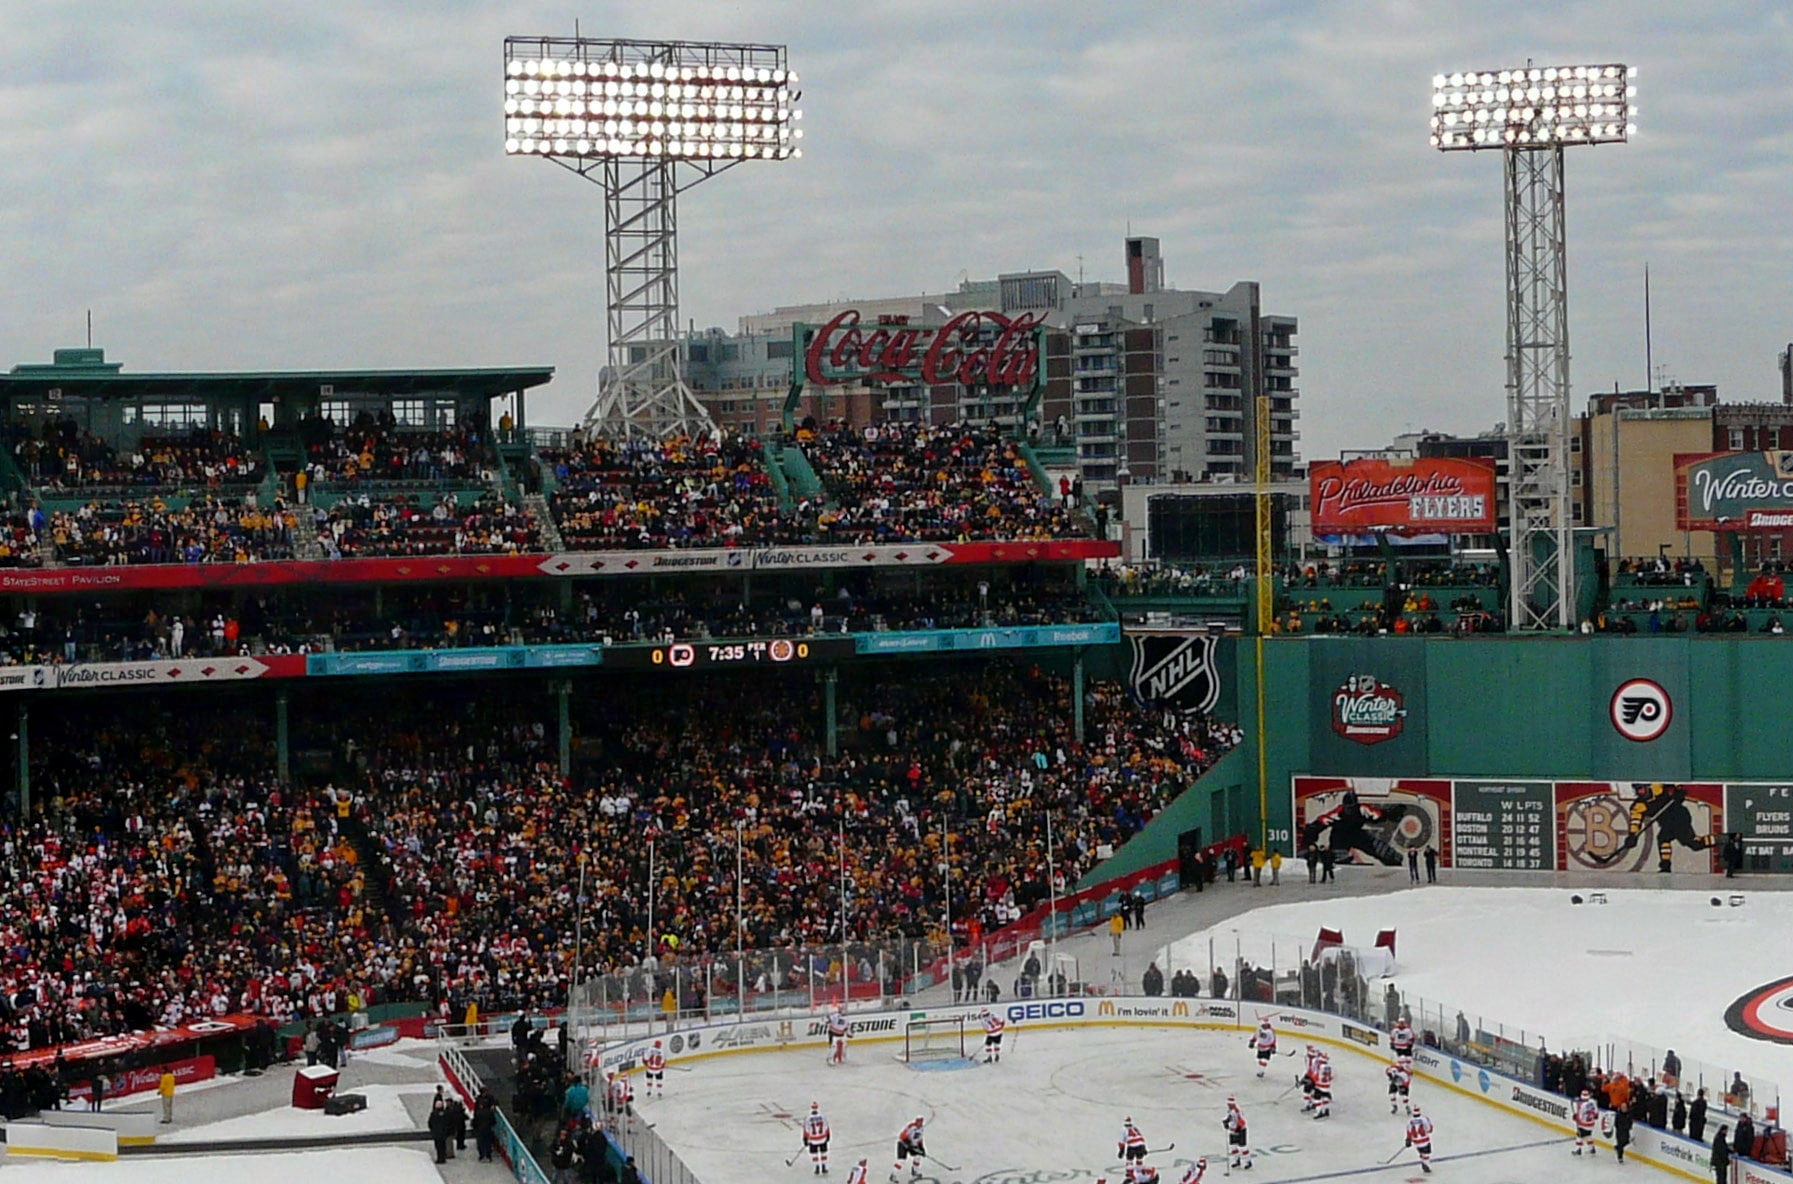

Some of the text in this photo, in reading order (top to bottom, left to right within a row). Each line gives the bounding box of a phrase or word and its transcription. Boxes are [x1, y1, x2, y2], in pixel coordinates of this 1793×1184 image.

[1317, 470, 1464, 516] Philadelphia
[1694, 468, 1782, 512] Winter
[1410, 493, 1486, 521] FLYERS
[654, 547, 849, 571] BRIDGESTONE Winter CLASSIC
[652, 645, 746, 666] 0 7:35
[797, 643, 809, 659] 0
[52, 664, 99, 687] Winter
[100, 667, 156, 682] CLASSIC
[1150, 652, 1203, 699] NHL
[1336, 692, 1398, 724] Winter
[1347, 711, 1397, 722] CLASSIC
[1501, 801, 1544, 811] W PTS
[1456, 812, 1492, 822] BUFFALO
[1756, 812, 1791, 822] FLYERS
[1268, 828, 1289, 842] 310
[1456, 824, 1488, 834] BOSTON
[1756, 824, 1790, 834] BRUINS
[1456, 835, 1488, 845] OTTAWA
[1456, 847, 1498, 857] MONTREAL
[1456, 858, 1493, 868] TORONTO
[1008, 1001, 1085, 1021] GEICO
[1160, 1006, 1169, 1017] it
[1512, 1086, 1569, 1121] BRIDGESTONE
[808, 1116, 826, 1132] 17
[1413, 1121, 1431, 1137] 44
[1660, 1140, 1695, 1163] Reethink
